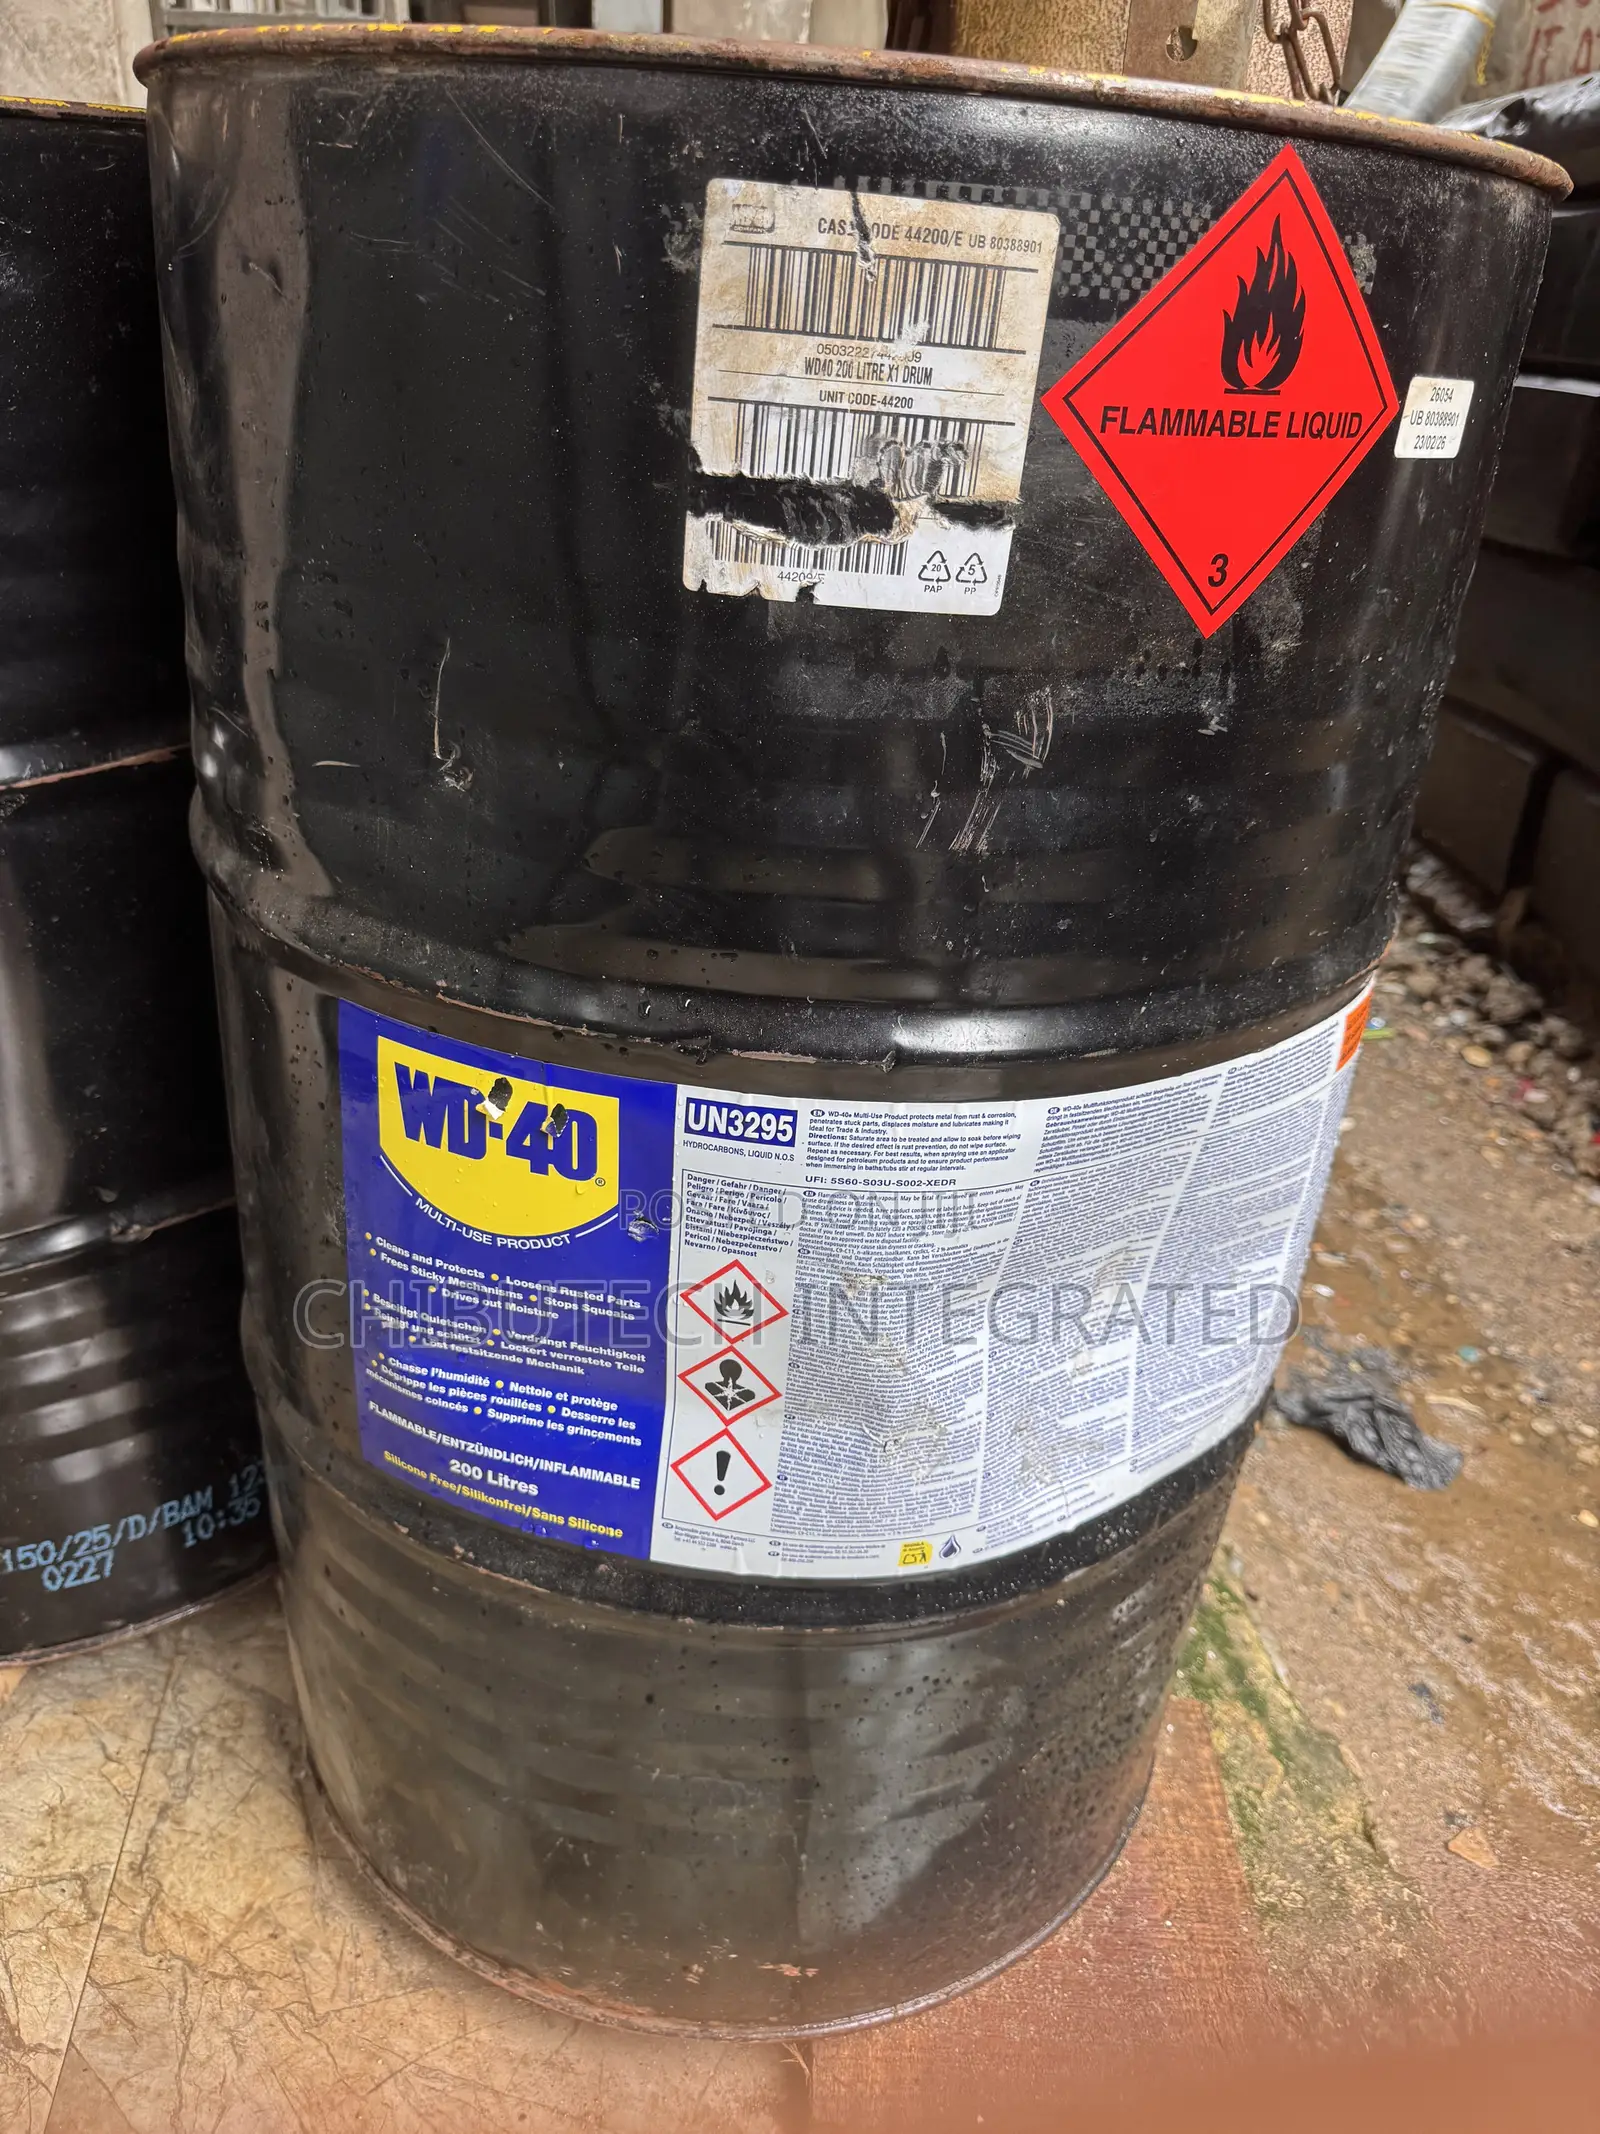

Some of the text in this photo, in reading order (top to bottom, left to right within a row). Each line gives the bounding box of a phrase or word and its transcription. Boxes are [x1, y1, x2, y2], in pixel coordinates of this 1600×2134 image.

[871, 221, 900, 240] ODE
[904, 225, 963, 248] 44200/E
[968, 234, 986, 249] UB
[990, 237, 1043, 254] 80388901
[804, 356, 933, 386] WD40 200 LITRE X1 DRUM
[819, 389, 914, 409] UNIT CODE-44200
[1430, 386, 1455, 403] 26054
[1100, 405, 1363, 440] FLAMMABLE LIQUID
[1410, 409, 1460, 427] UB 80388901
[1414, 434, 1447, 450] 23/02/26
[931, 563, 976, 576] 20 5
[1207, 553, 1229, 588] 3
[923, 584, 977, 595] PAP PP
[394, 1060, 598, 1182] WD-40
[687, 1102, 794, 1143] UN3295
[809, 1118, 843, 1126] penetrates
[862, 1120, 881, 1128] parts,
[881, 1120, 911, 1129] displaces
[911, 1120, 939, 1128] moisture
[982, 1119, 1004, 1127] making
[836, 1126, 854, 1134] Trade
[884, 1112, 908, 1120] Product
[909, 1113, 934, 1121] protects
[682, 1139, 795, 1162] HYDROCARBONS, LIQUID N.O.S
[808, 1132, 847, 1141] Directions:
[848, 1134, 875, 1142] Saturate
[982, 1133, 1002, 1141] before
[806, 1155, 835, 1163] designed
[846, 1157, 878, 1165] petroleum
[949, 1157, 973, 1165] product
[807, 1147, 829, 1156] Repeat
[941, 1150, 967, 1159] spraying
[804, 1175, 957, 1187] UFI: 5S60-S03U-S002-XEDR
[916, 1165, 939, 1173] regular
[686, 1181, 782, 1203] Peligro Perigo Pericolo
[687, 1173, 782, 1196] Danger Gefahr Danger
[415, 1197, 572, 1250] MULTI-USE PRODUCT
[684, 1231, 711, 1242] Pericol
[684, 1239, 757, 1258] Nevarno Opasnost
[375, 1236, 642, 1309] Cleans and Protects Loosens Rusted Parts
[380, 1252, 636, 1321] Frees Sticky Mechanisms Stops Squeaks
[441, 1287, 560, 1320] Drives out Moisture
[411, 1323, 434, 1336] und
[500, 1341, 548, 1357] Lockert
[549, 1351, 613, 1368] verrostete
[614, 1361, 645, 1374] Teile
[420, 1312, 487, 1334] Quietschen
[506, 1330, 568, 1349] Verdrängt
[569, 1341, 647, 1363] Feuchtigkeit
[450, 1341, 524, 1364] festsitzende
[526, 1357, 585, 1375] Mechanik
[380, 1363, 637, 1431] Dégrippe les pièces rouillées Desserre les
[387, 1356, 619, 1412] Chasse l'humidité Nettoie et protège
[365, 1367, 642, 1447] mécanismes coincés Supprime les grincements
[368, 1400, 641, 1490] FLAMMABLE/ENTZÜNDLICH/INFLAMMABLE
[449, 1459, 540, 1497] 200 Litres
[382, 1450, 624, 1539] Silicone Free/Silikonfrei/Sans Silicone
[41, 1550, 115, 1592] 0227
